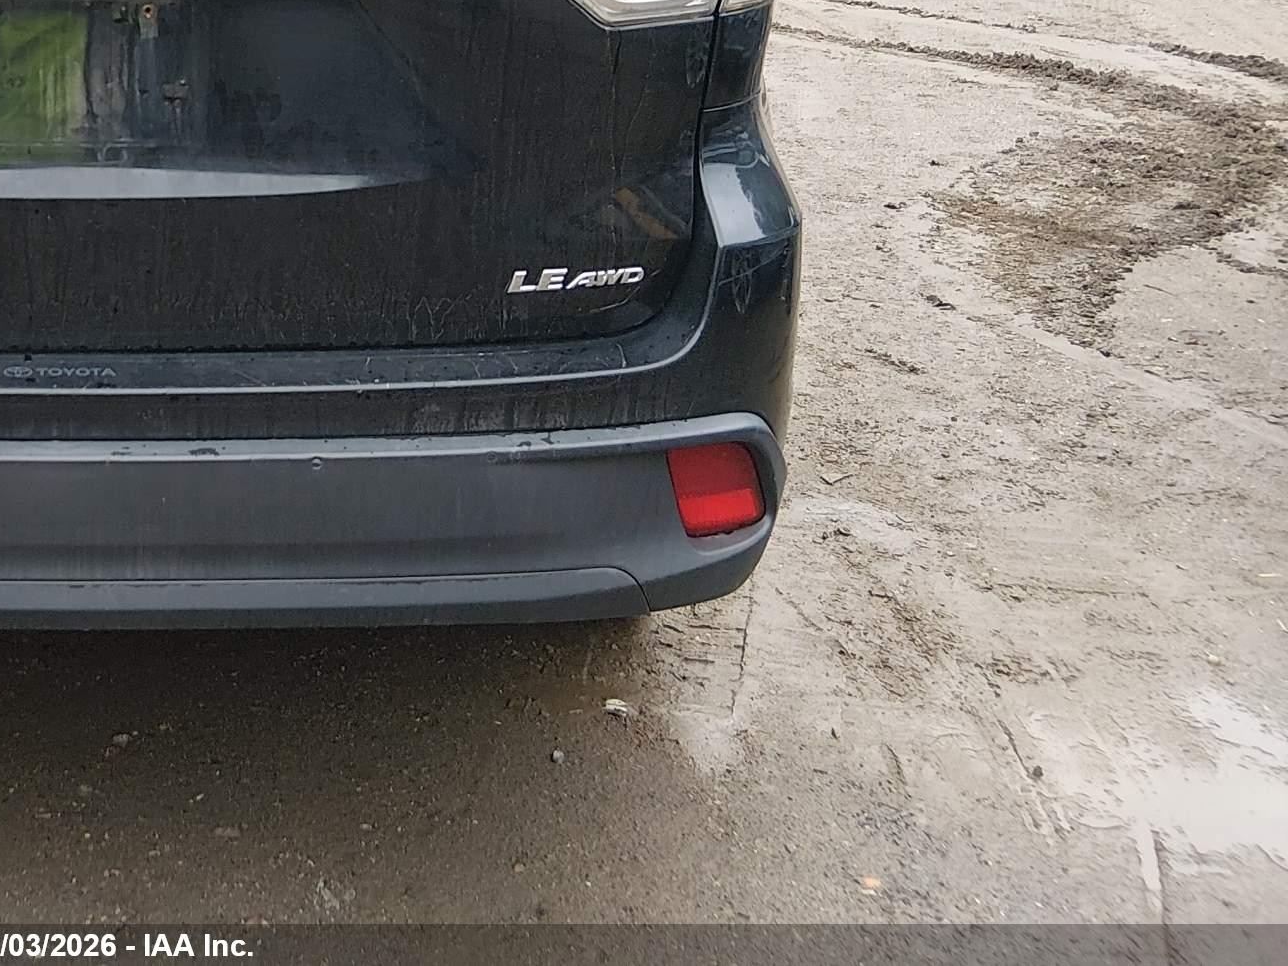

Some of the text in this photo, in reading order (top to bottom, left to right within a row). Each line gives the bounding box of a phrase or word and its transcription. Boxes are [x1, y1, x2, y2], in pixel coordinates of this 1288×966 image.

[507, 266, 645, 294] LE AWD
[36, 367, 117, 377] TOYOTA
